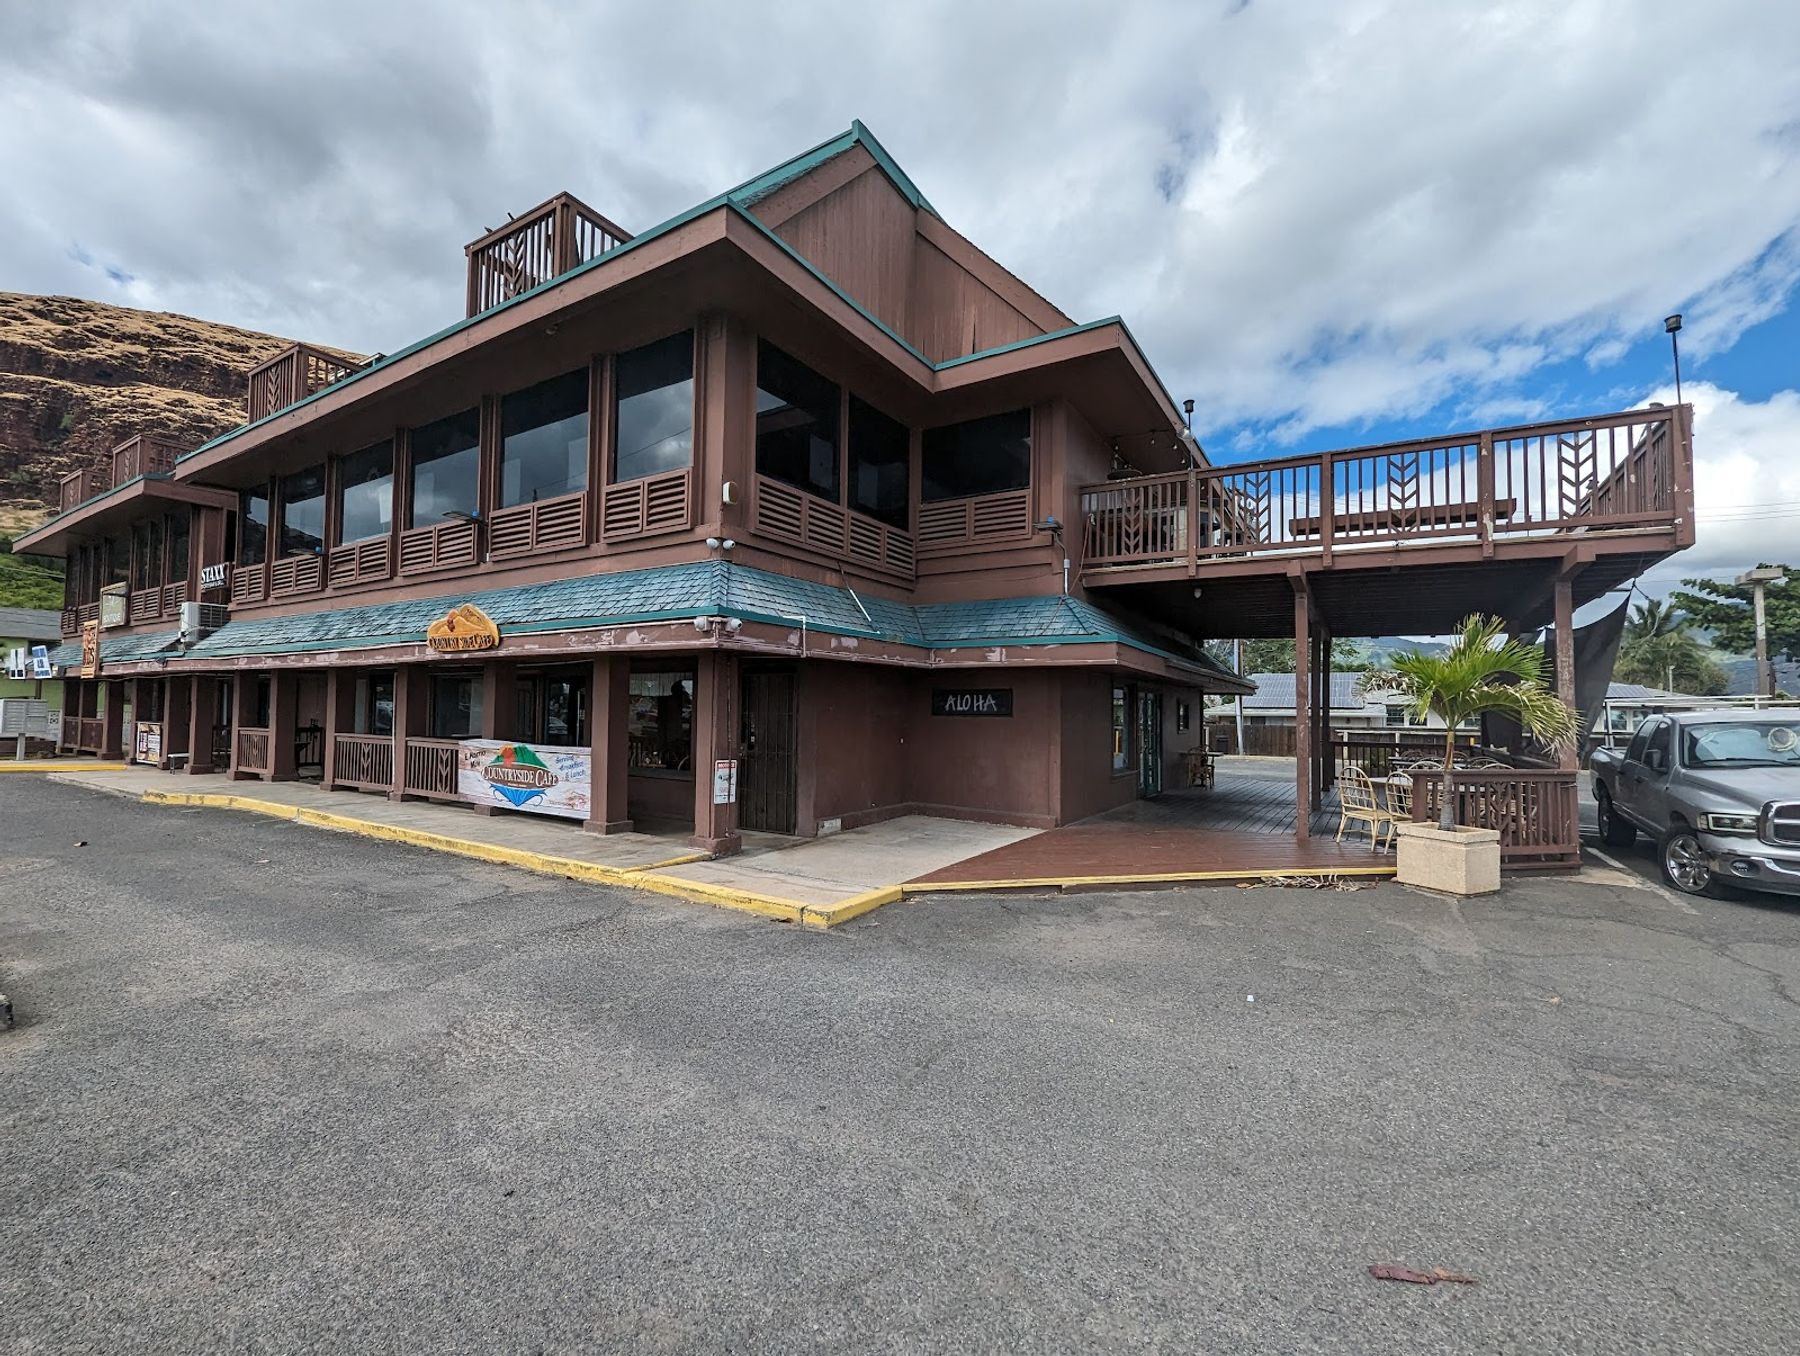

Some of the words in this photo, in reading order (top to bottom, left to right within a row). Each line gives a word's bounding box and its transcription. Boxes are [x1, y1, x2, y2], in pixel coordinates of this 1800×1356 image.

[201, 564, 225, 583] STAXX
[944, 694, 997, 712] ALOHA
[481, 765, 534, 784] COUNTRYSIDE
[535, 769, 557, 787] CAFE
